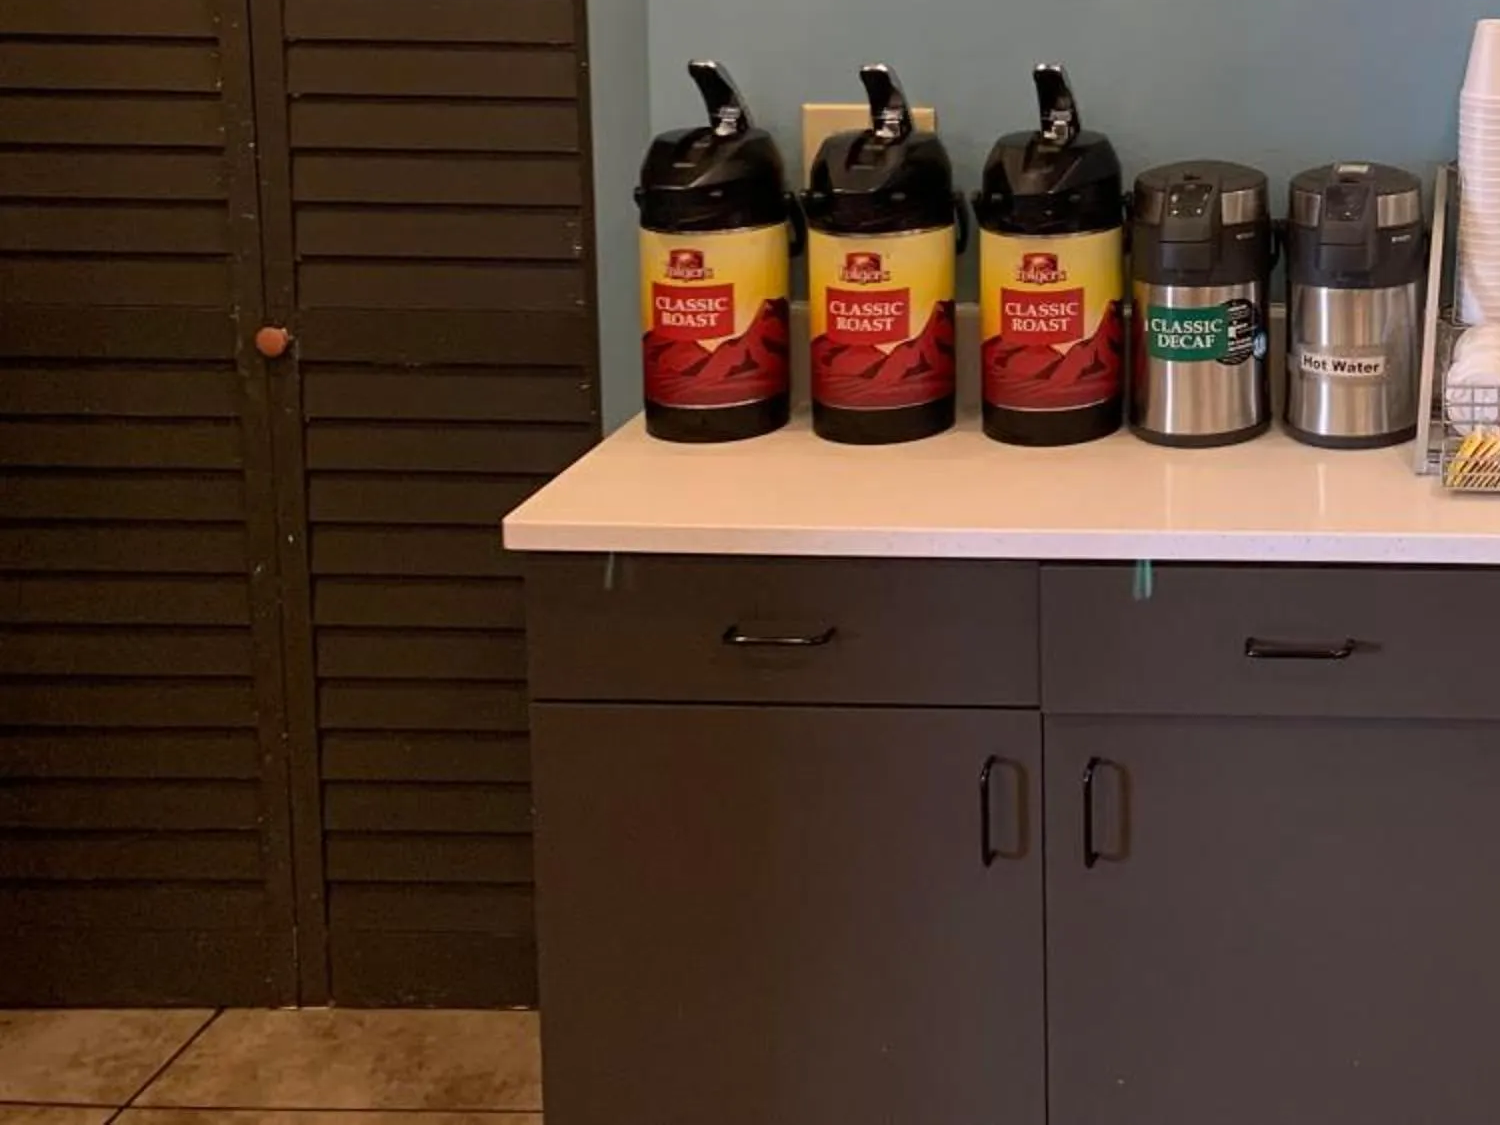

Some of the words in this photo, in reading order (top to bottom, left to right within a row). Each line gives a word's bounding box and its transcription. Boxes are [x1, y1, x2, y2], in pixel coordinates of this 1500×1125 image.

[655, 296, 729, 312] CLASSIC
[829, 300, 905, 316] CLASSIC
[1004, 302, 1079, 317] CLASSIC
[661, 311, 720, 327] ROAST
[835, 316, 896, 332] ROAST
[1011, 317, 1072, 332] ROAST
[1151, 318, 1223, 334] CLASSIC
[1157, 334, 1216, 348] DECAF
[1304, 355, 1327, 370] Hot
[1332, 359, 1380, 373] Water
